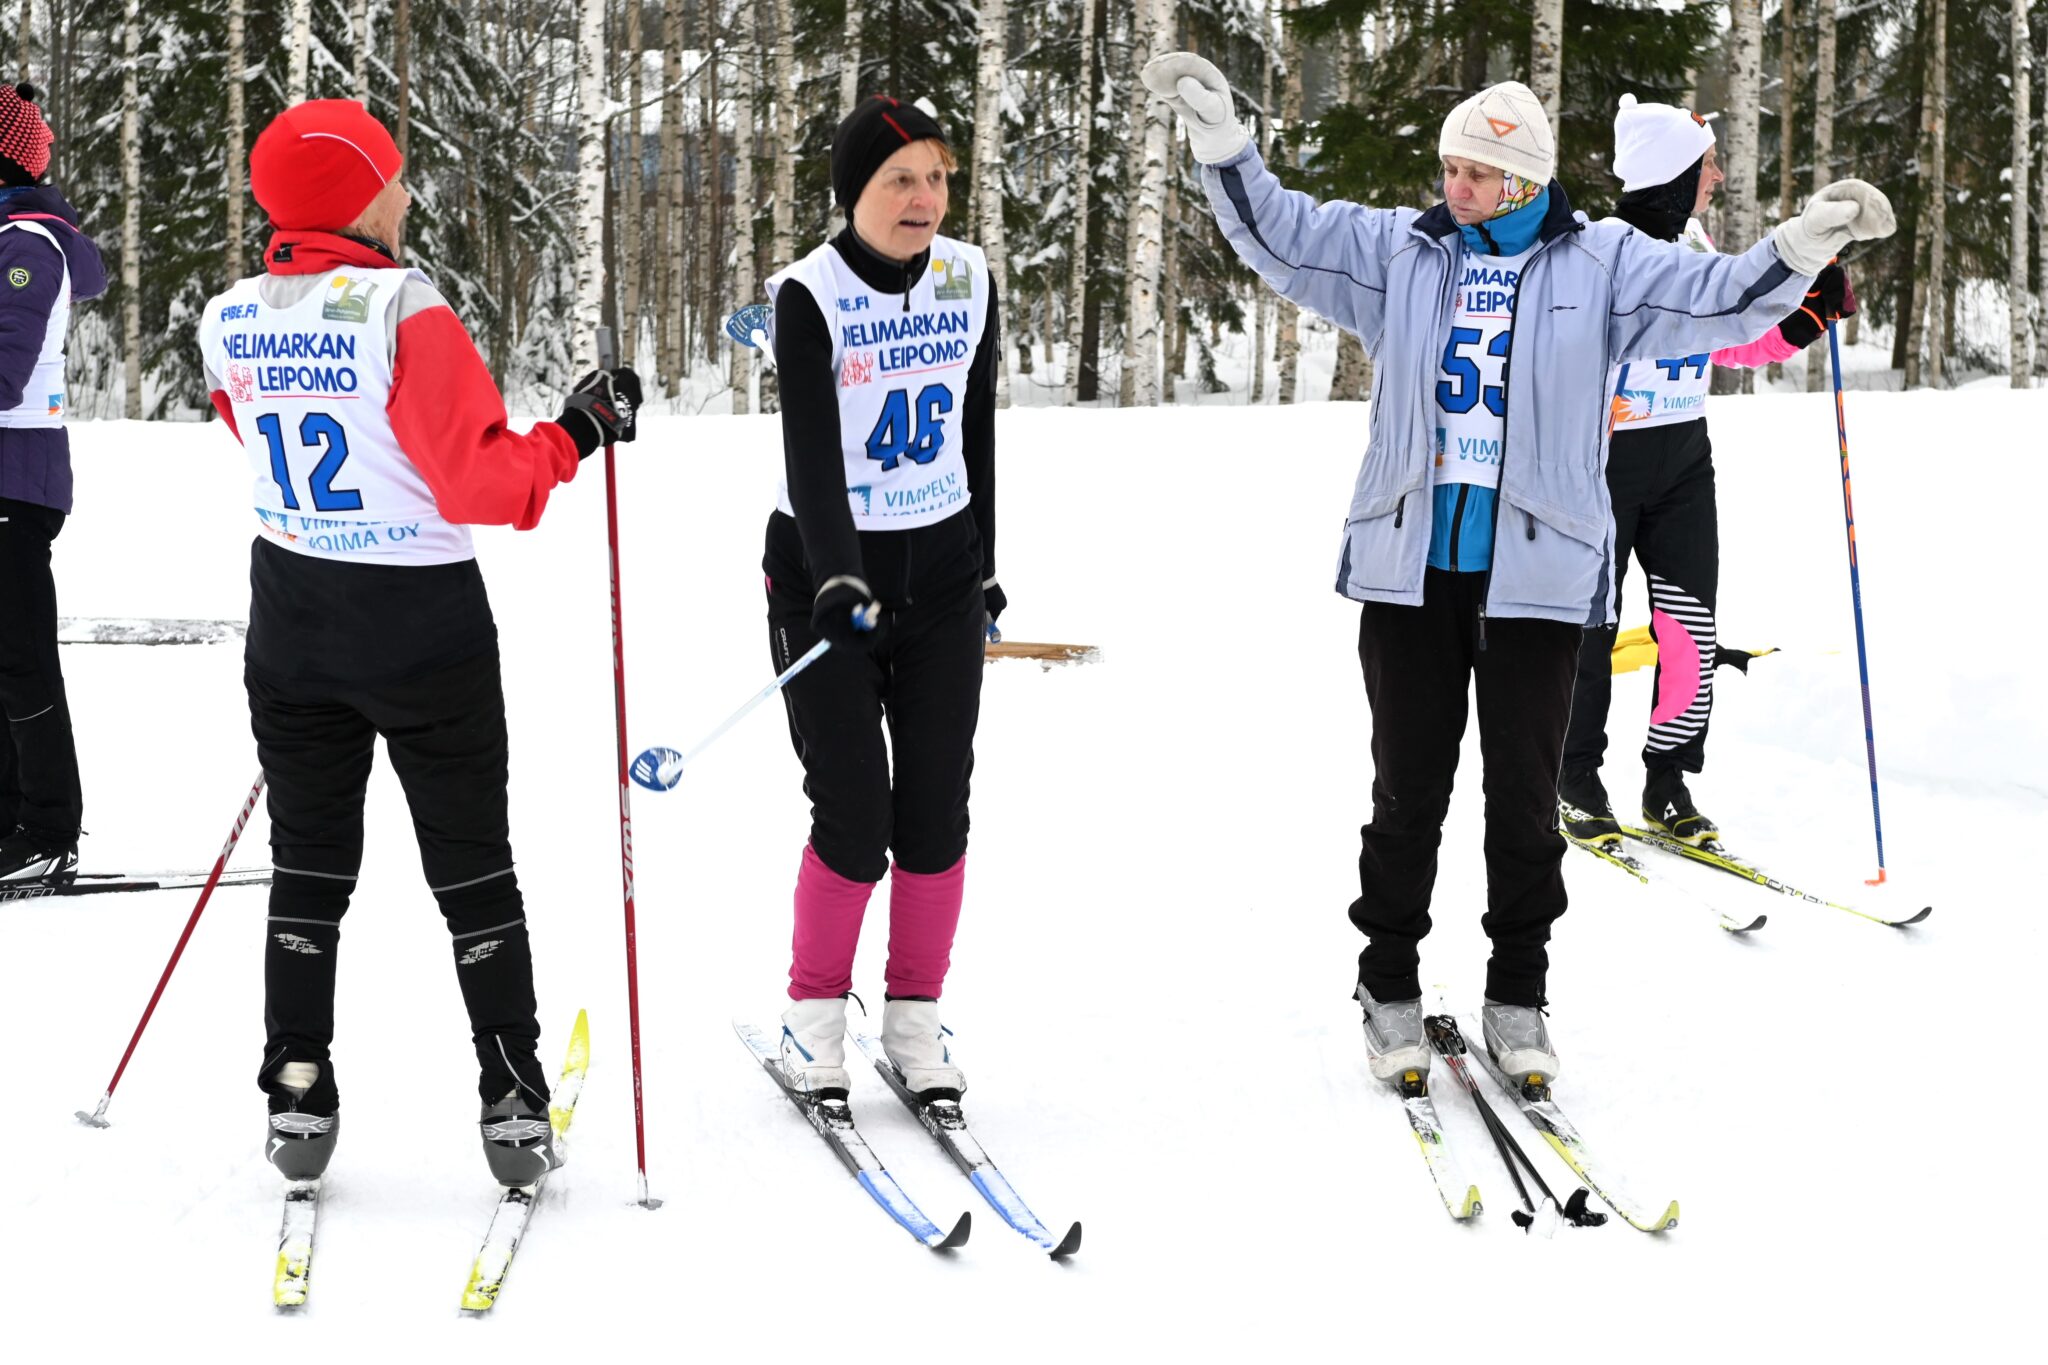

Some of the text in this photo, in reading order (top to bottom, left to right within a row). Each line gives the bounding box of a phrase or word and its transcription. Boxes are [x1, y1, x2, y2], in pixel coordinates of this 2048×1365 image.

[1459, 267, 1518, 289] IMAR
[221, 303, 258, 322] FIBE.FI
[842, 311, 968, 347] NELIMARKAN
[223, 333, 356, 359] NELIMARKAN
[879, 339, 968, 371] LEIPOMO
[257, 366, 358, 392] LEIPOMO
[1435, 326, 1510, 417] 53
[865, 382, 953, 472] 46
[1457, 437, 1499, 456] VIM
[256, 412, 364, 511] 12
[388, 523, 419, 541] OY
[1641, 835, 1684, 855] FISCHER
